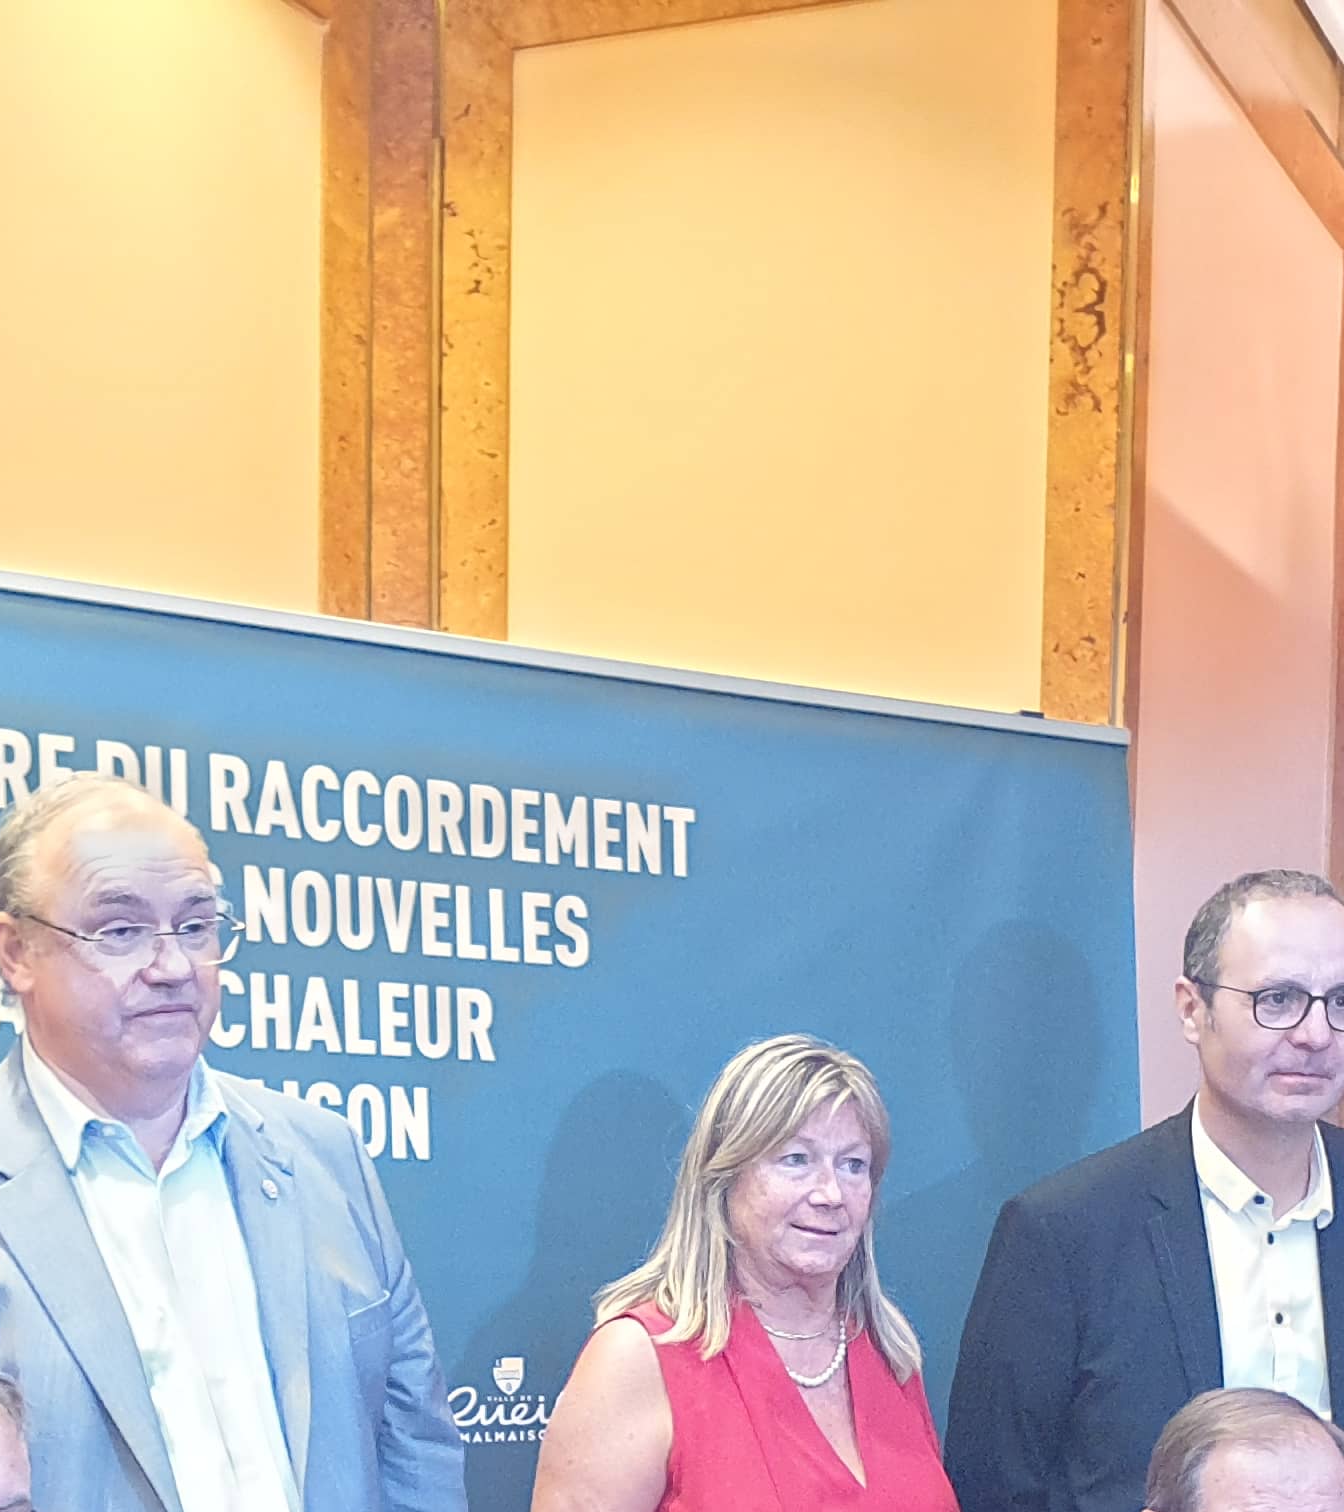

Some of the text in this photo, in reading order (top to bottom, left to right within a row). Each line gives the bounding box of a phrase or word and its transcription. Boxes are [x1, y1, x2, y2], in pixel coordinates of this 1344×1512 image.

[209, 753, 696, 877] RACCORDEMENT
[243, 865, 590, 968] NOUVELLES
[208, 971, 496, 1061] CHALEUR
